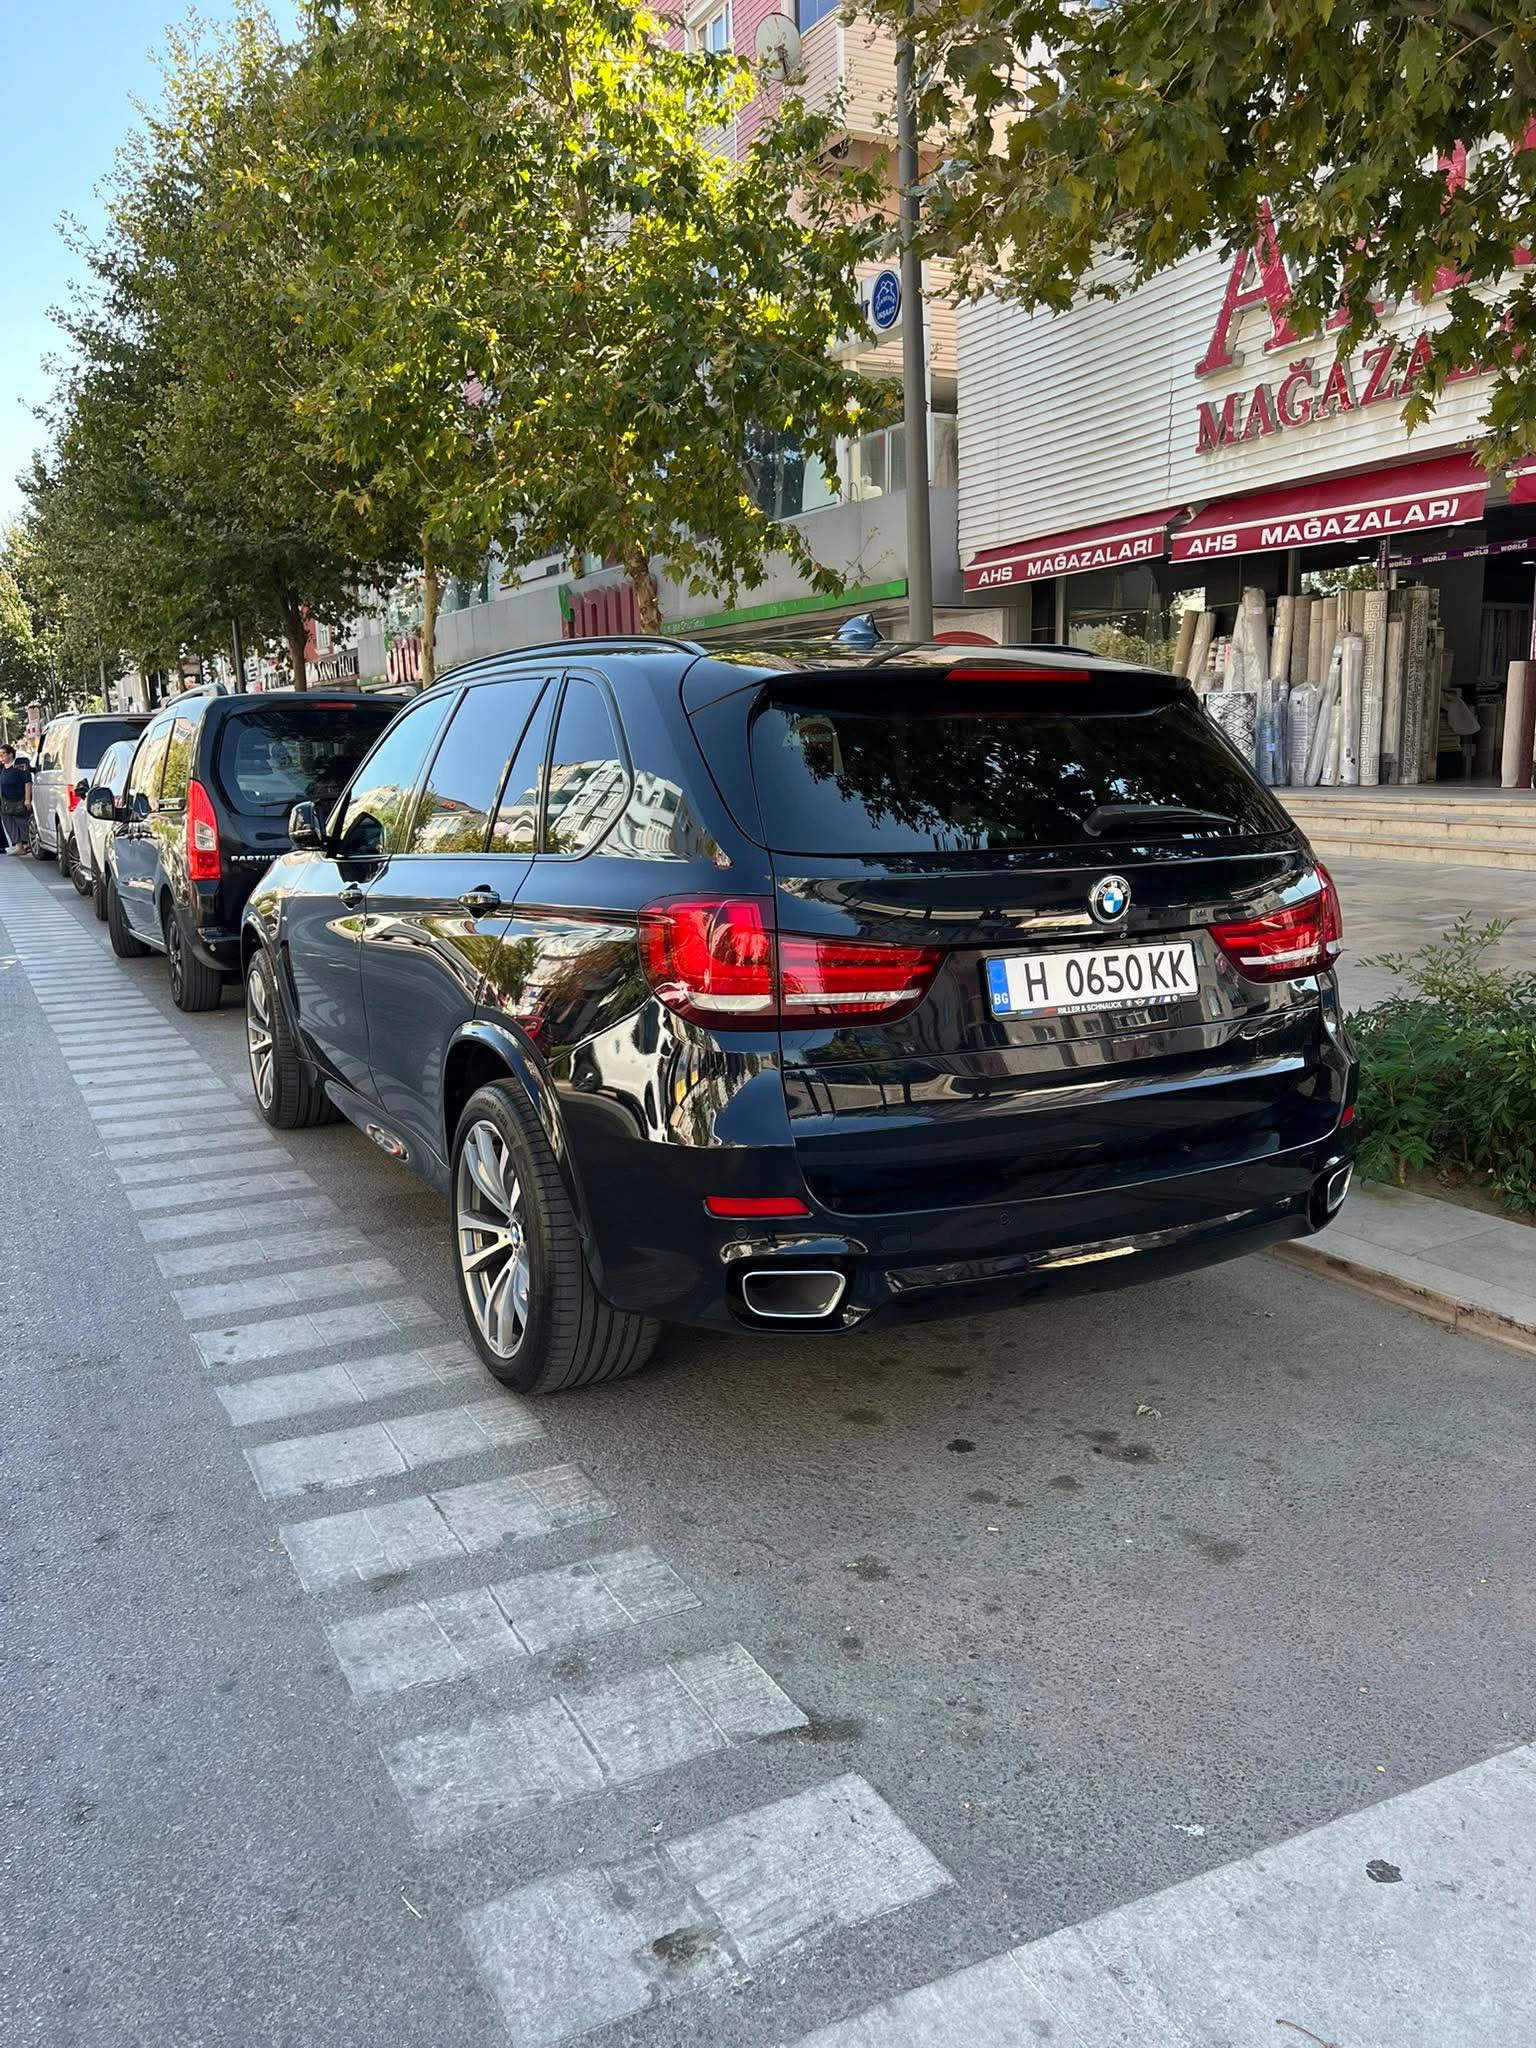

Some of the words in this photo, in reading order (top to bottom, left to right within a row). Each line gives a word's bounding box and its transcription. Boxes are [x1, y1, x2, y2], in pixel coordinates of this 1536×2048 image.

[1186, 534, 1238, 556] AHS
[1261, 498, 1460, 546] MAĞAZALARI
[1501, 542, 1528, 552] WORLD
[1422, 554, 1447, 563] WORLD
[1463, 548, 1489, 558] WORLD
[978, 567, 1013, 585] AHS
[1027, 537, 1153, 577] MAĞAZALARI
[1389, 559, 1412, 568] WORLD
[1024, 961, 1049, 1002] H
[994, 992, 1009, 1005] BG
